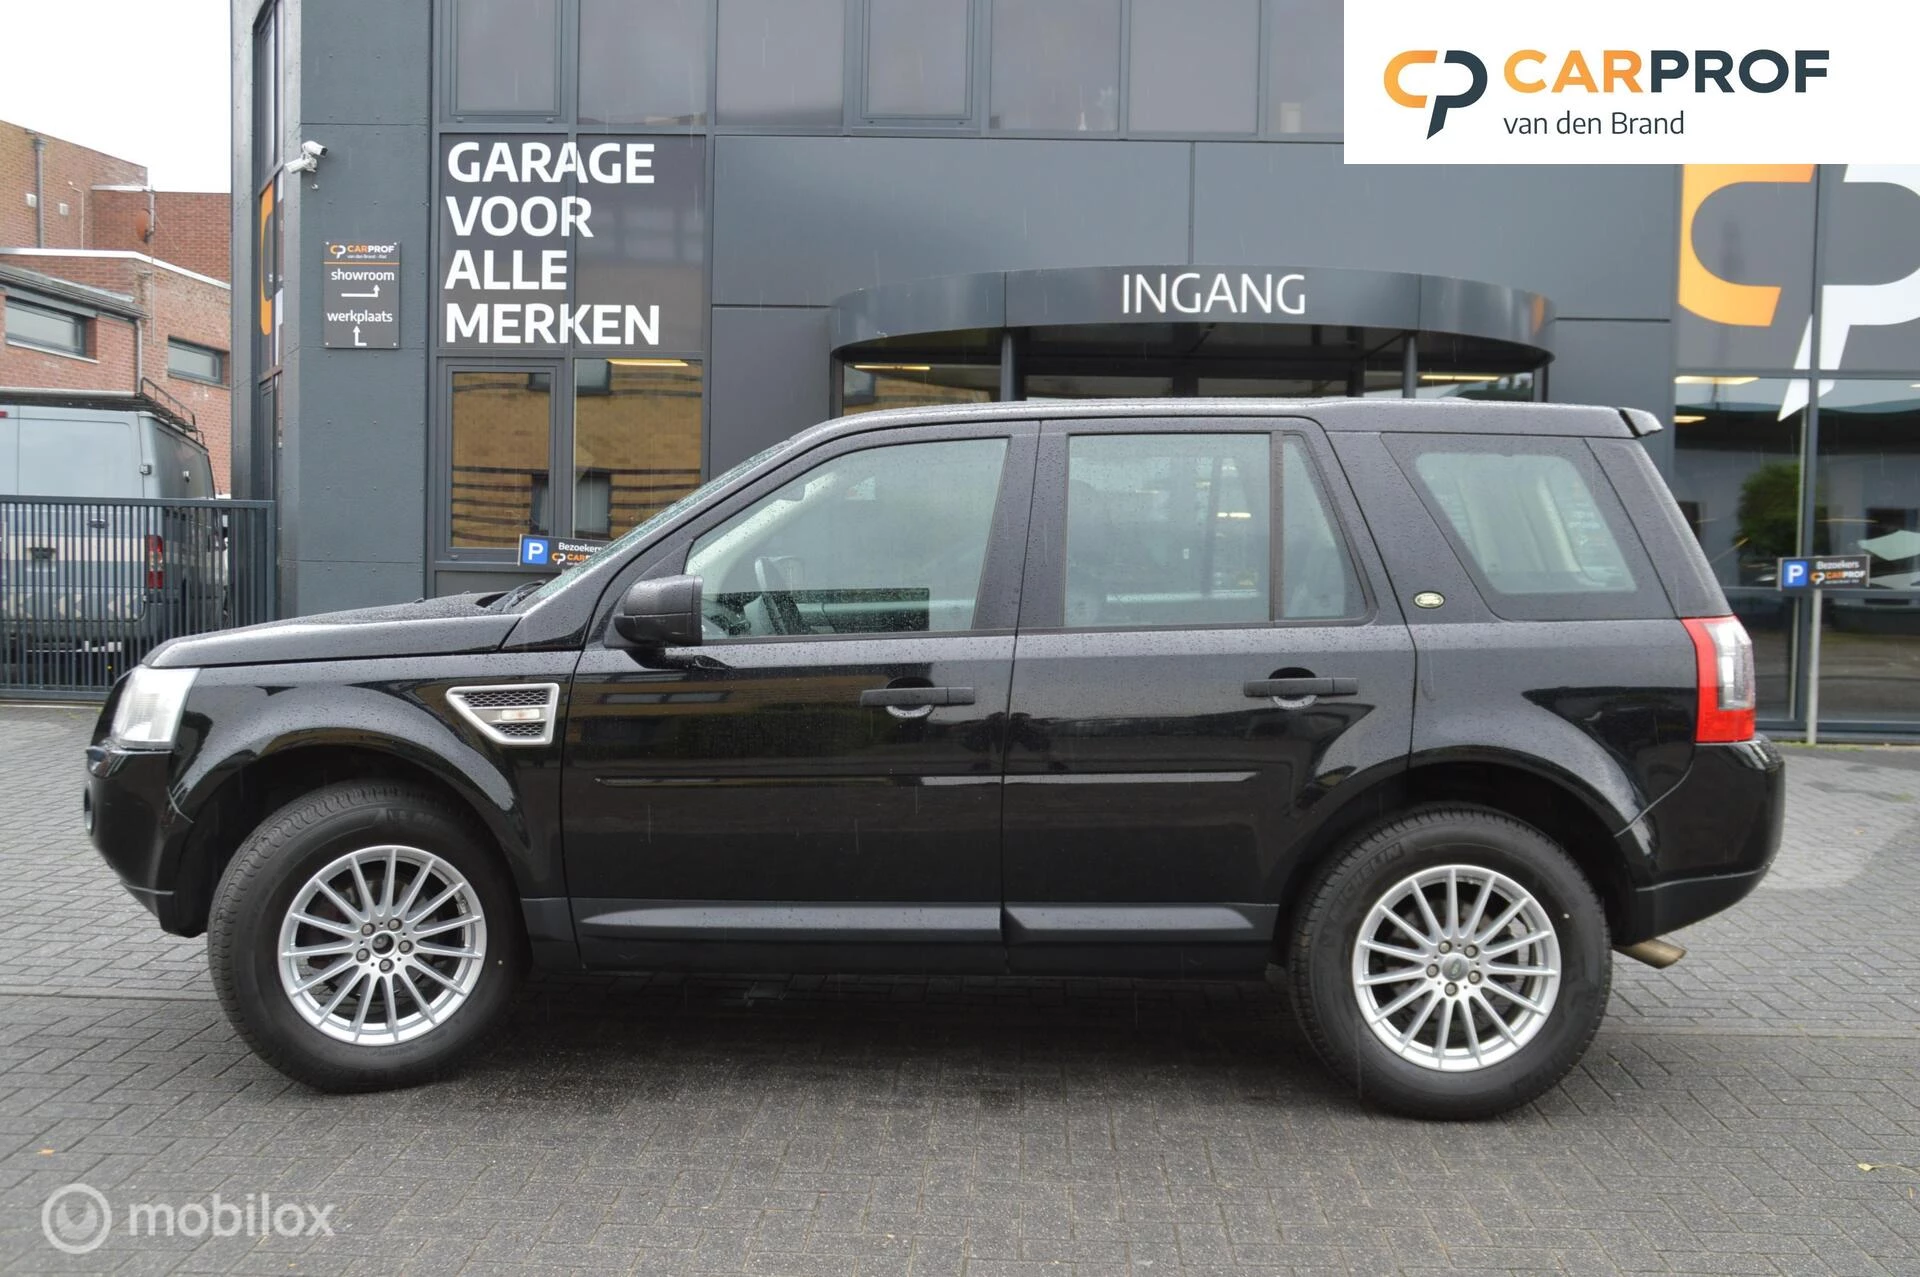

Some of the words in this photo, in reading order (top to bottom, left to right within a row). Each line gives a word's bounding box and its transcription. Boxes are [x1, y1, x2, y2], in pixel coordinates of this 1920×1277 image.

[448, 141, 655, 184] GARAGE
[445, 195, 594, 238] VOOR
[347, 244, 395, 254] CARPROF
[330, 268, 395, 281] showroom
[444, 249, 568, 290] ALLE
[1123, 272, 1306, 315] INGANG
[327, 309, 393, 325] werkplaats
[446, 303, 660, 345] MERKEN
[528, 542, 544, 560] P
[1788, 564, 1804, 583] P
[1816, 560, 1860, 570] Bezoekers
[1826, 570, 1866, 579] CARPROF
